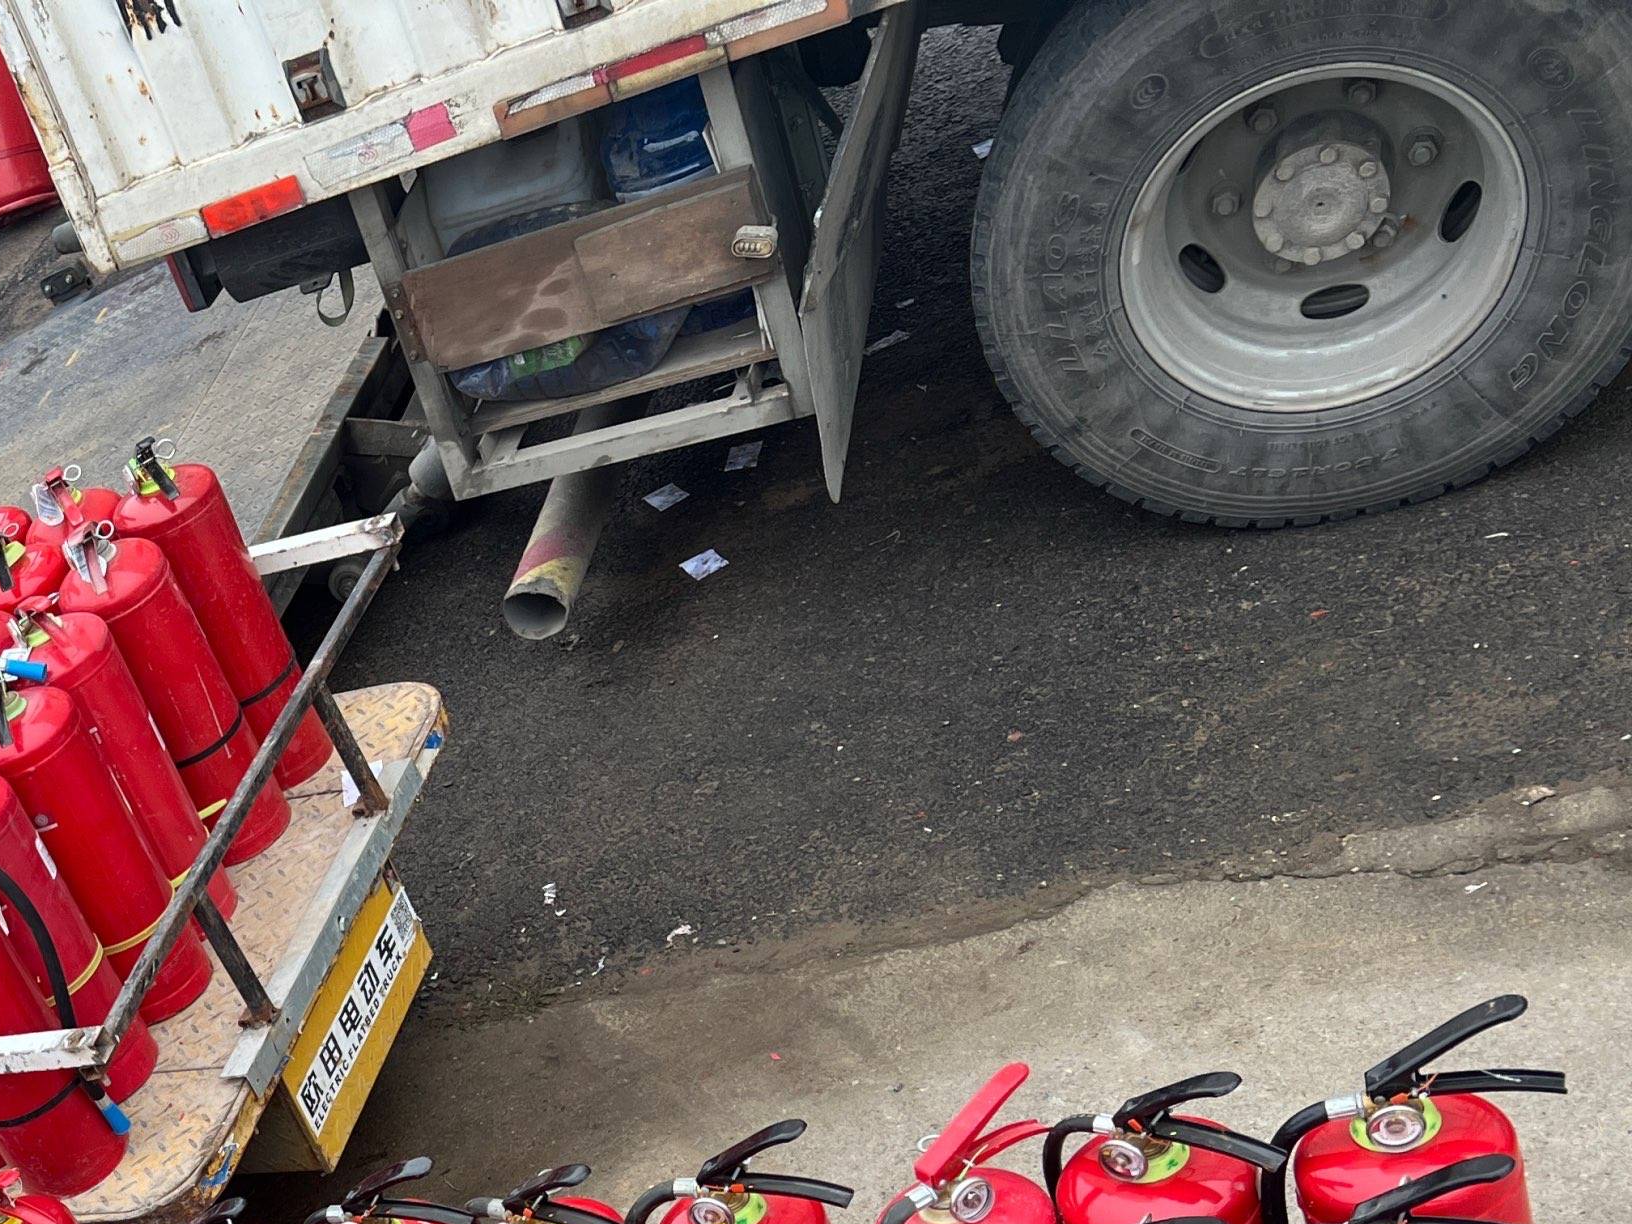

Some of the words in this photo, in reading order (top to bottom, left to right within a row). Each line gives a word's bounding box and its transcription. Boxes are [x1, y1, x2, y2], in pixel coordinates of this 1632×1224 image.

[1510, 107, 1609, 391] LINGLONG
[300, 925, 396, 1119] 欧田电动车
[314, 1061, 350, 1130] ELECTRIC
[348, 997, 381, 1061] FLATBED
[380, 953, 403, 998] TRUCK
